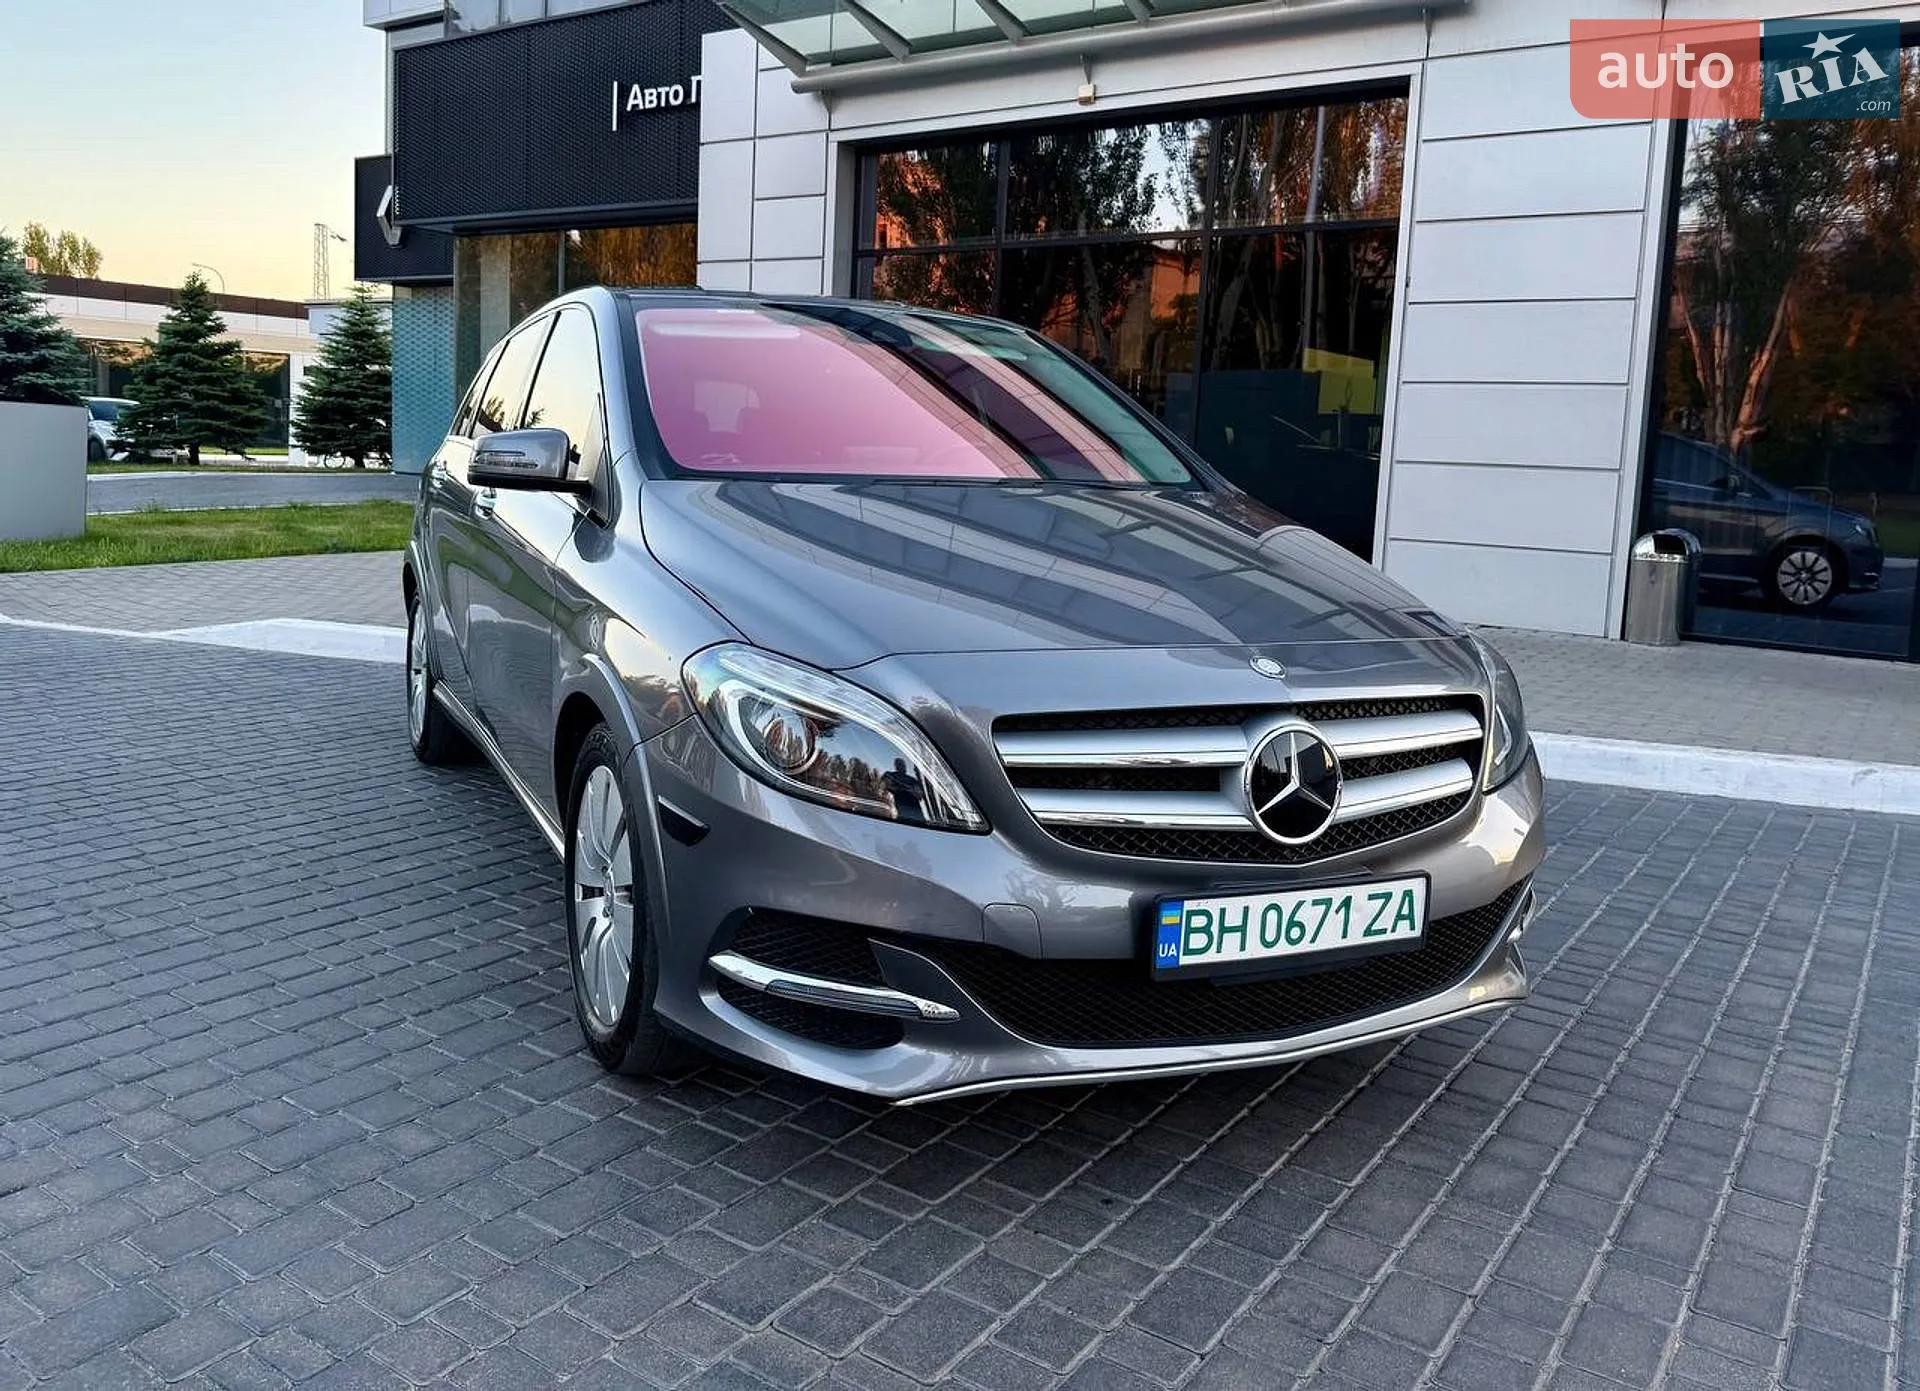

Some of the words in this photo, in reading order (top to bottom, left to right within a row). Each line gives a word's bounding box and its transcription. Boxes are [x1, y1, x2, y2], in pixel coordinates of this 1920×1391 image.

[626, 83, 684, 112] Авто
[1182, 905, 1250, 957] BH
[1259, 895, 1353, 949] 0671
[1362, 888, 1416, 938] ZA
[1159, 942, 1178, 958] UA
